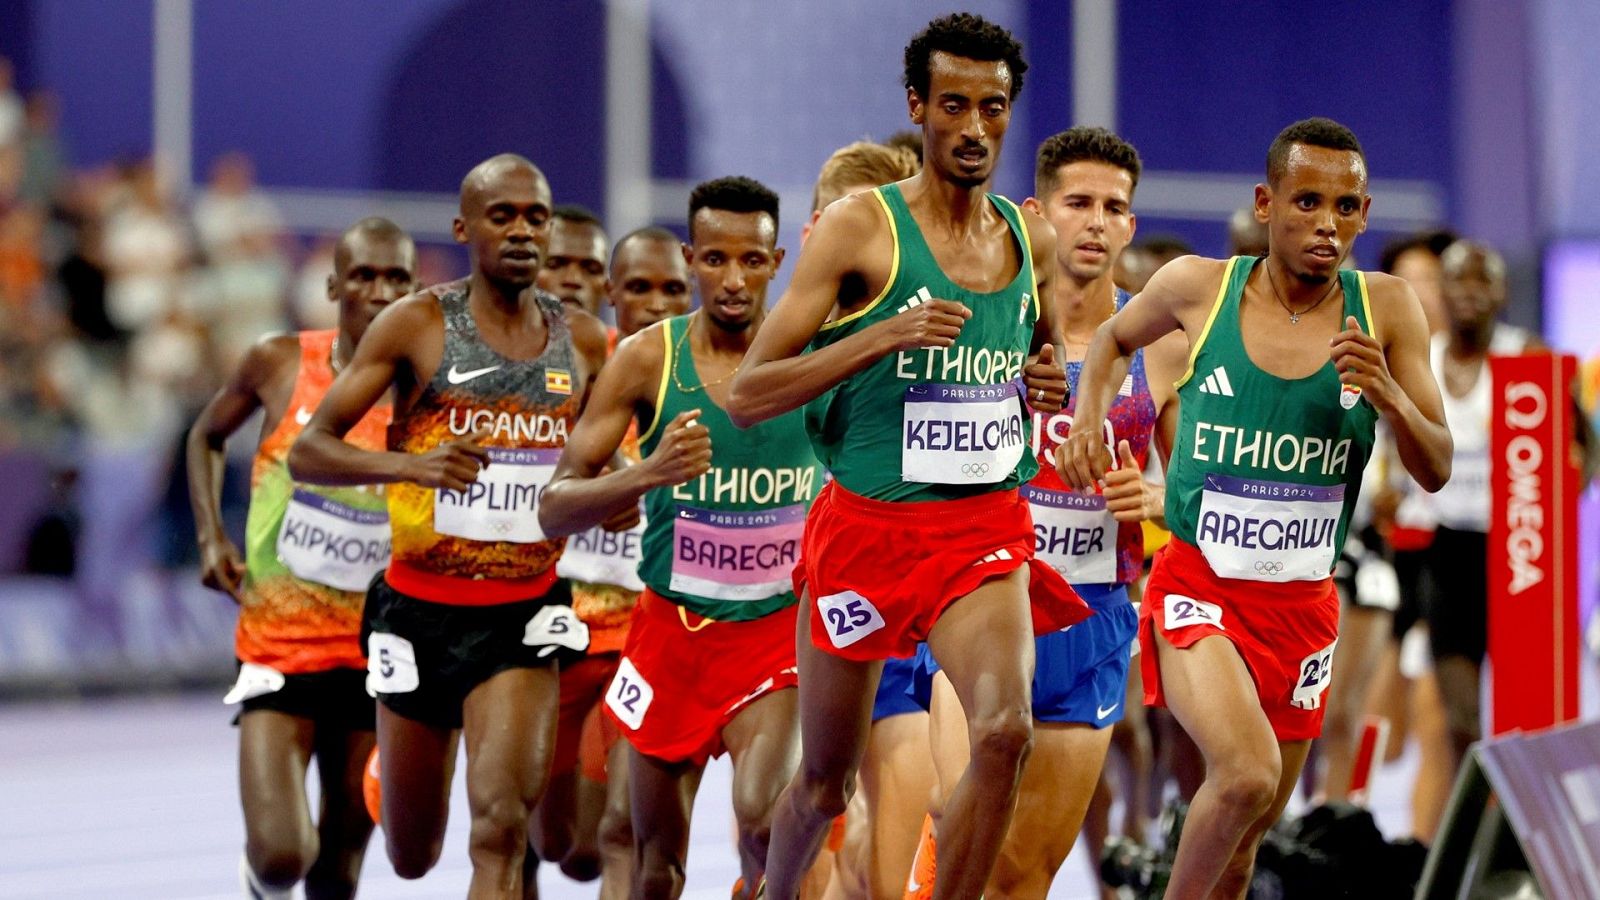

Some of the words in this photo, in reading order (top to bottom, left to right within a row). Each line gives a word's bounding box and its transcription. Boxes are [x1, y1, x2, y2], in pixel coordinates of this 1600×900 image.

[942, 389, 976, 399] PARIS
[449, 407, 569, 443] UGANDA
[906, 414, 1022, 452] KEJELCHA
[1192, 421, 1352, 476] ETHIOPIA
[440, 482, 549, 512] KIPLIM
[673, 466, 815, 504] ETHIOPIA
[1029, 490, 1063, 505] PARIS
[1067, 495, 1098, 507] 2024
[1243, 483, 1279, 496] PARIS
[1283, 487, 1314, 498] 2024
[709, 514, 744, 525] PARIS
[748, 514, 777, 526] 2024
[1200, 510, 1335, 551] AREGAWI
[1506, 435, 1544, 595] OMEGA
[282, 518, 392, 565] KIPKORI
[574, 528, 642, 559] KIBE
[680, 535, 796, 571] BAREGA
[1034, 523, 1105, 557] SHER
[548, 616, 569, 634] 5
[827, 599, 872, 636] 25
[379, 648, 395, 679] 5
[616, 675, 642, 715] 12
